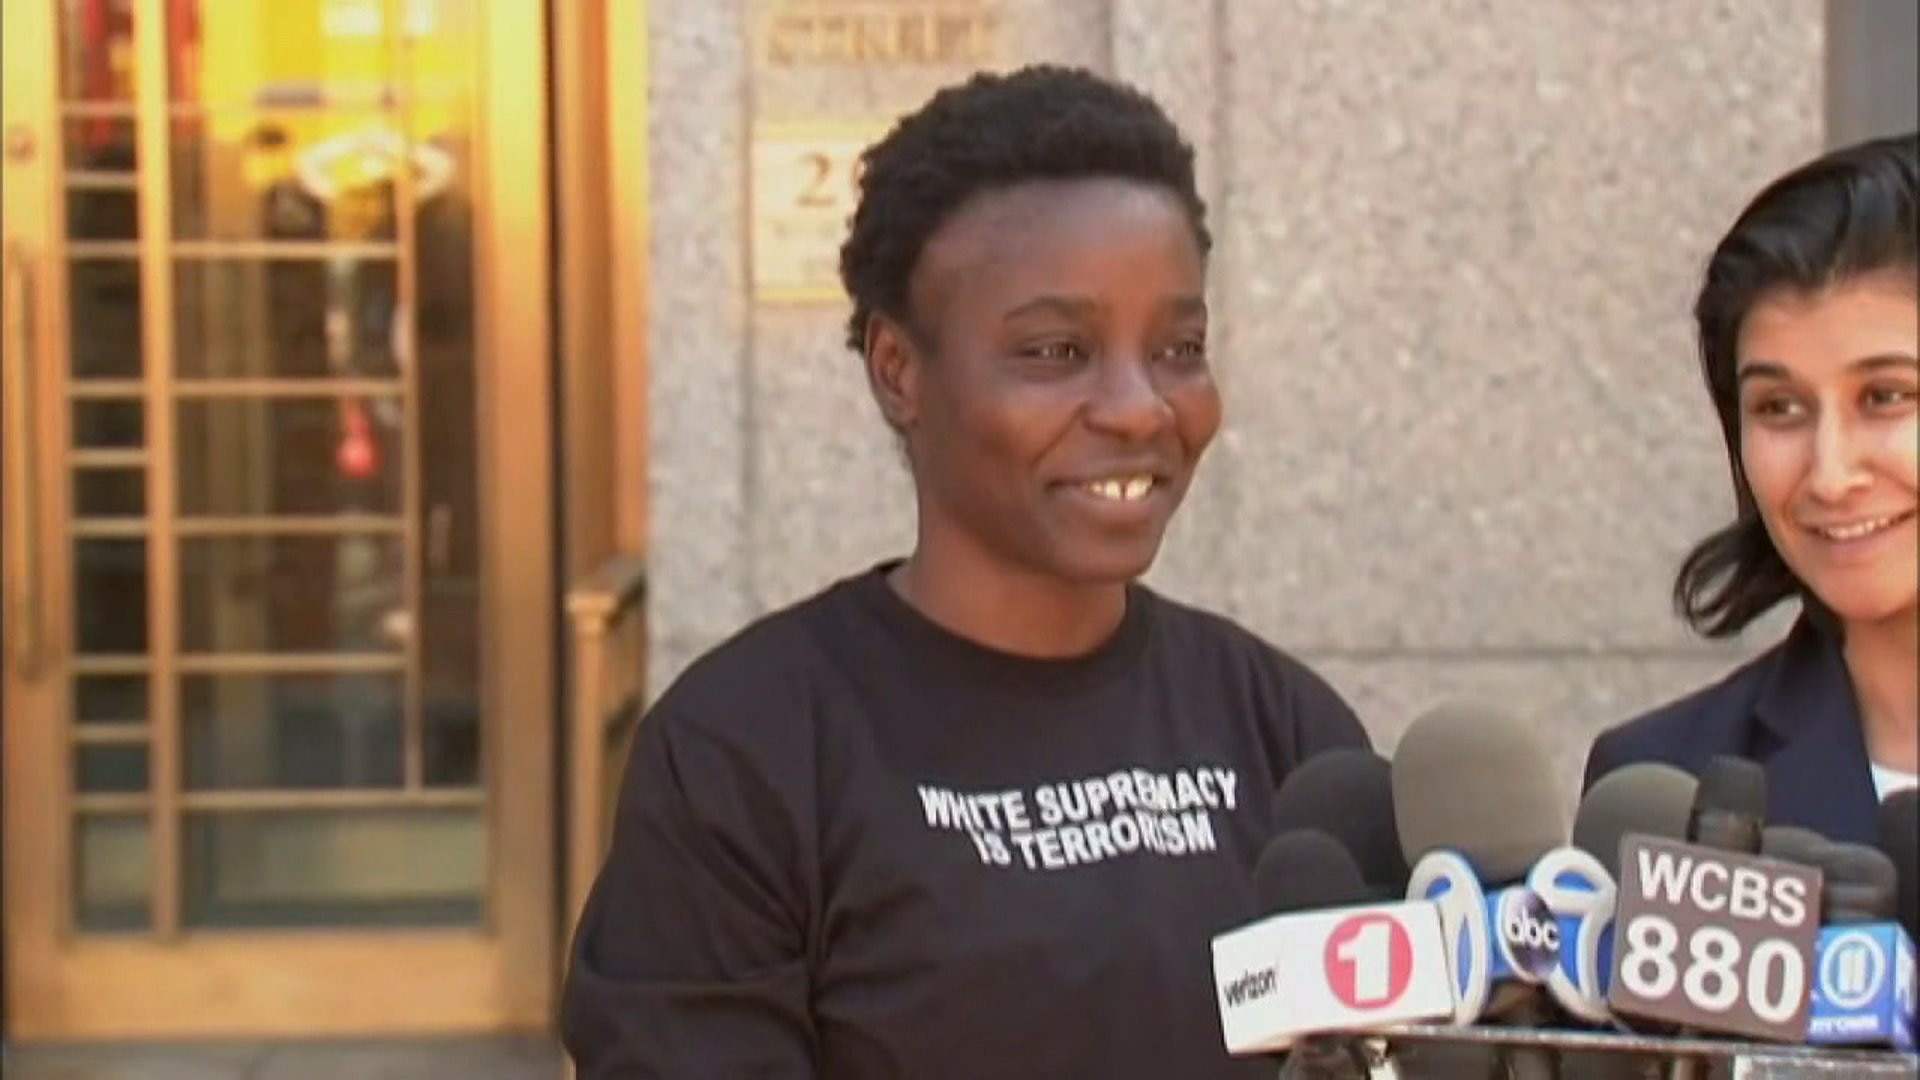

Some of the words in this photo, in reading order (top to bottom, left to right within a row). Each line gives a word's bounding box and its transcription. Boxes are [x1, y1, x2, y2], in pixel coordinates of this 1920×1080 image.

[917, 784, 1031, 830] WHITE
[1035, 767, 1239, 826] SUPREMACY
[971, 828, 1012, 866] IS
[1011, 810, 1216, 870] TERRORISM
[1638, 847, 1807, 926] WCBS
[1507, 908, 1561, 951] abc
[1224, 966, 1278, 1008] verizon
[1337, 922, 1392, 1003] 1
[1620, 914, 1804, 1023] 880
